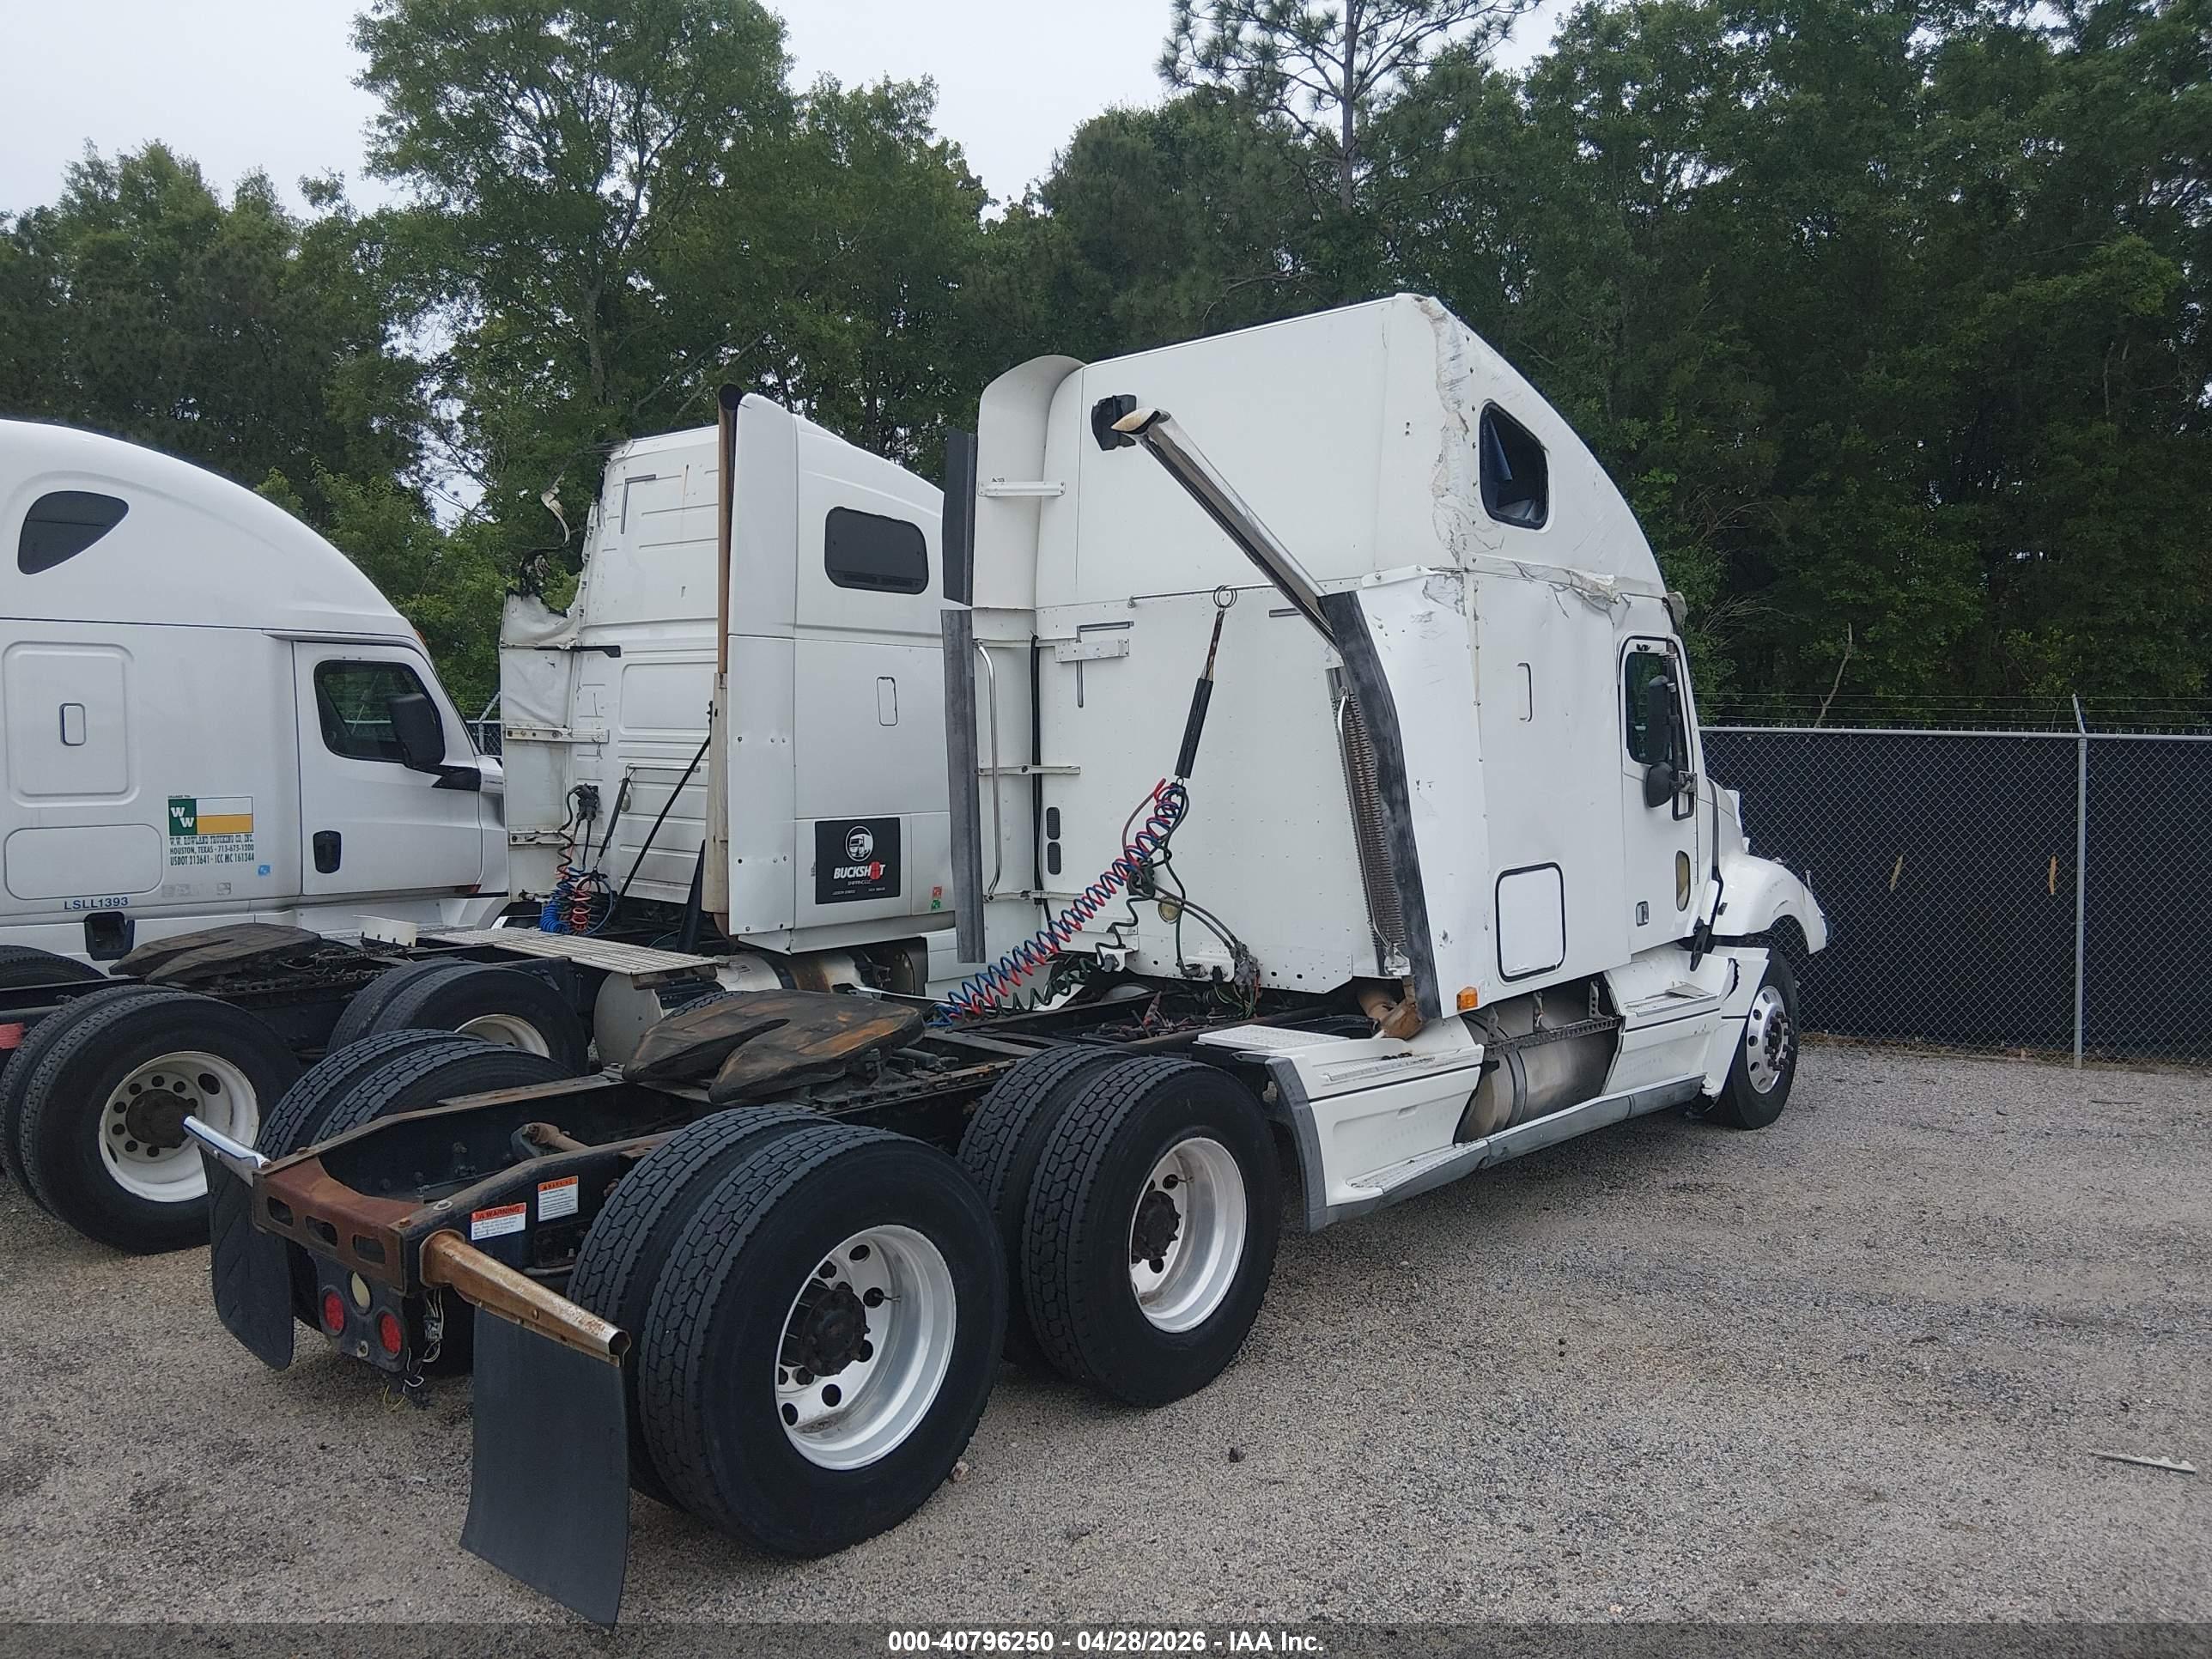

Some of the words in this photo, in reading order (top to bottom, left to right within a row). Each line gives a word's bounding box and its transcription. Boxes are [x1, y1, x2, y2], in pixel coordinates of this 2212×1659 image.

[170, 807, 185, 817] W
[179, 817, 195, 828] W
[198, 845, 214, 854] TEXAS
[170, 855, 188, 866] USDOT
[189, 854, 210, 866] 213641
[215, 854, 223, 864] ICC
[224, 853, 234, 864] MC
[234, 852, 254, 863] 161344
[64, 896, 129, 910] LSLL1393
[486, 1205, 520, 1218] WARNING
